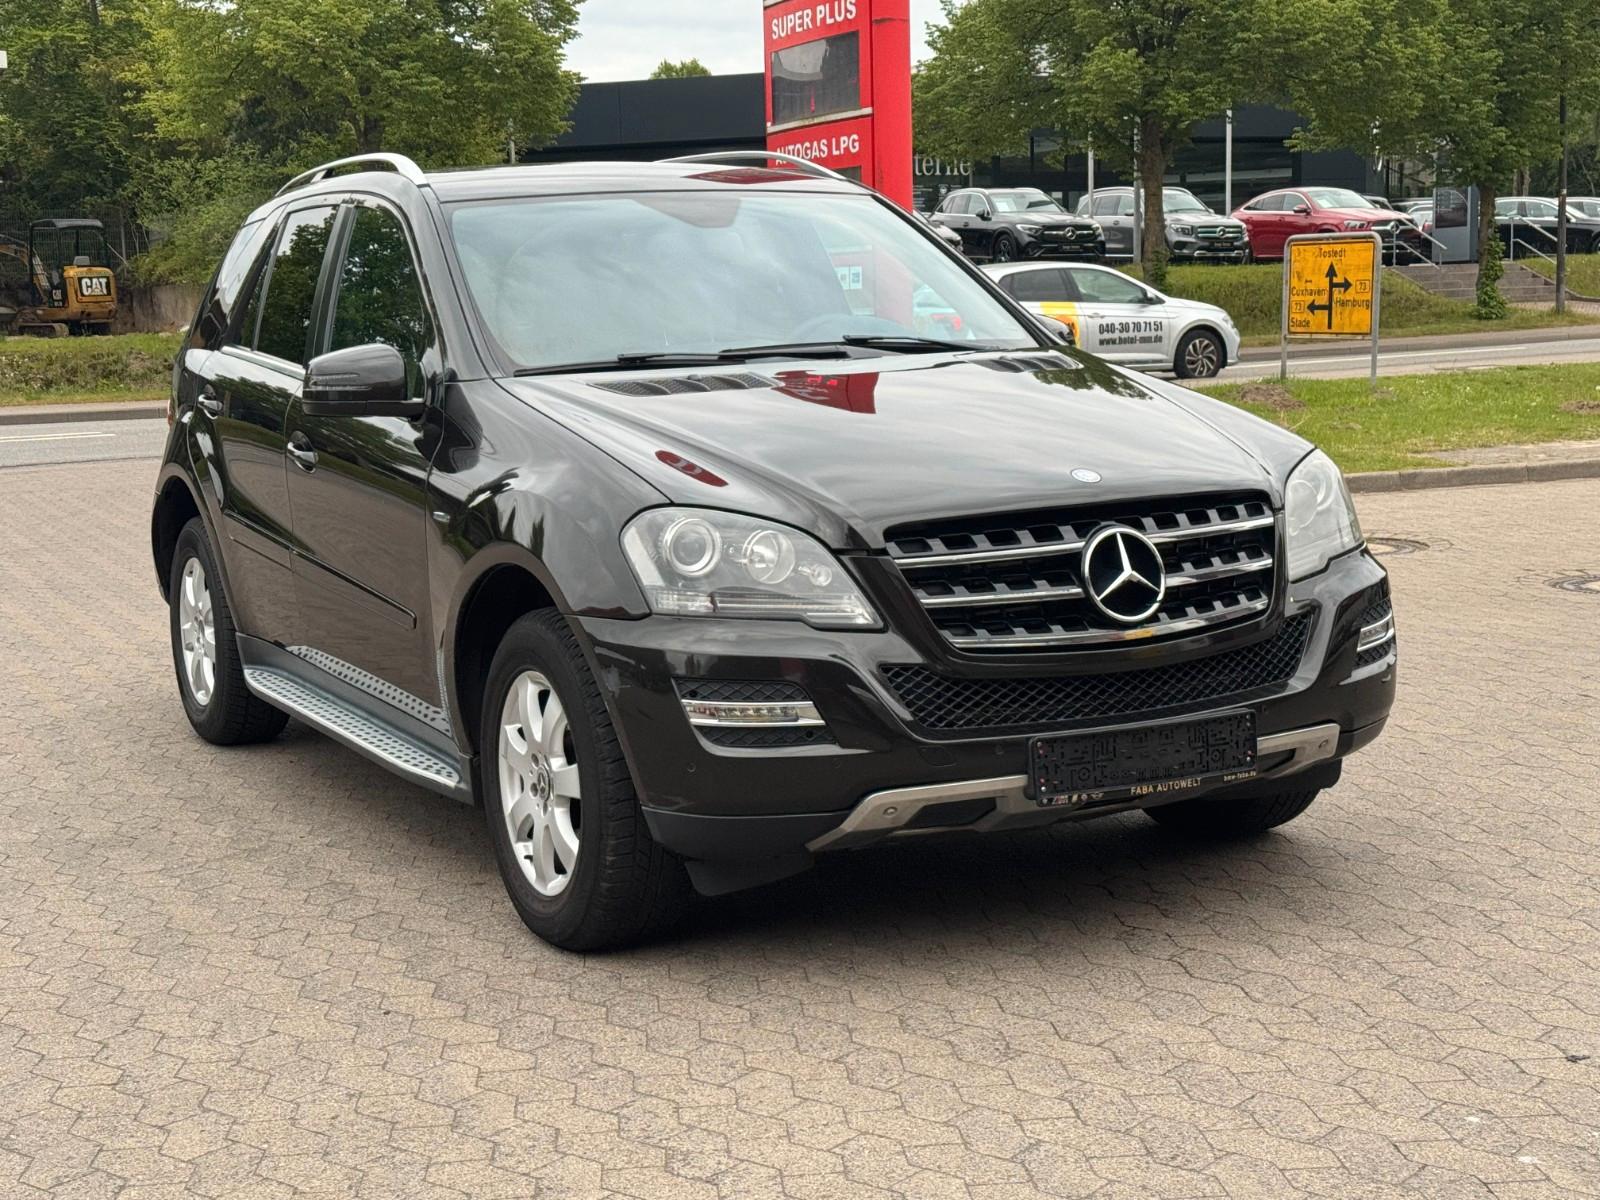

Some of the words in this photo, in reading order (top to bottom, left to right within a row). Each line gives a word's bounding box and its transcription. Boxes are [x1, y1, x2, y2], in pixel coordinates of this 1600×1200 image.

[771, 8, 813, 40] SUPER
[816, 0, 857, 27] PLUS
[775, 138, 829, 166] AUTOGAS
[831, 134, 860, 156] LPG
[1319, 247, 1347, 259] Tostedt
[81, 277, 108, 296] CAT
[1291, 286, 1326, 297] Cuxhaven
[1358, 281, 1367, 291] 73
[1294, 302, 1303, 312] 73
[1334, 296, 1370, 310] Hamburg
[1098, 322, 1130, 335] 040-30
[1131, 321, 1142, 333] 70
[1143, 320, 1152, 332] 71
[1153, 320, 1163, 332] 51
[1290, 317, 1311, 328] Stade
[1130, 784, 1154, 796] FABA
[1156, 777, 1202, 793] AUTOWELT
